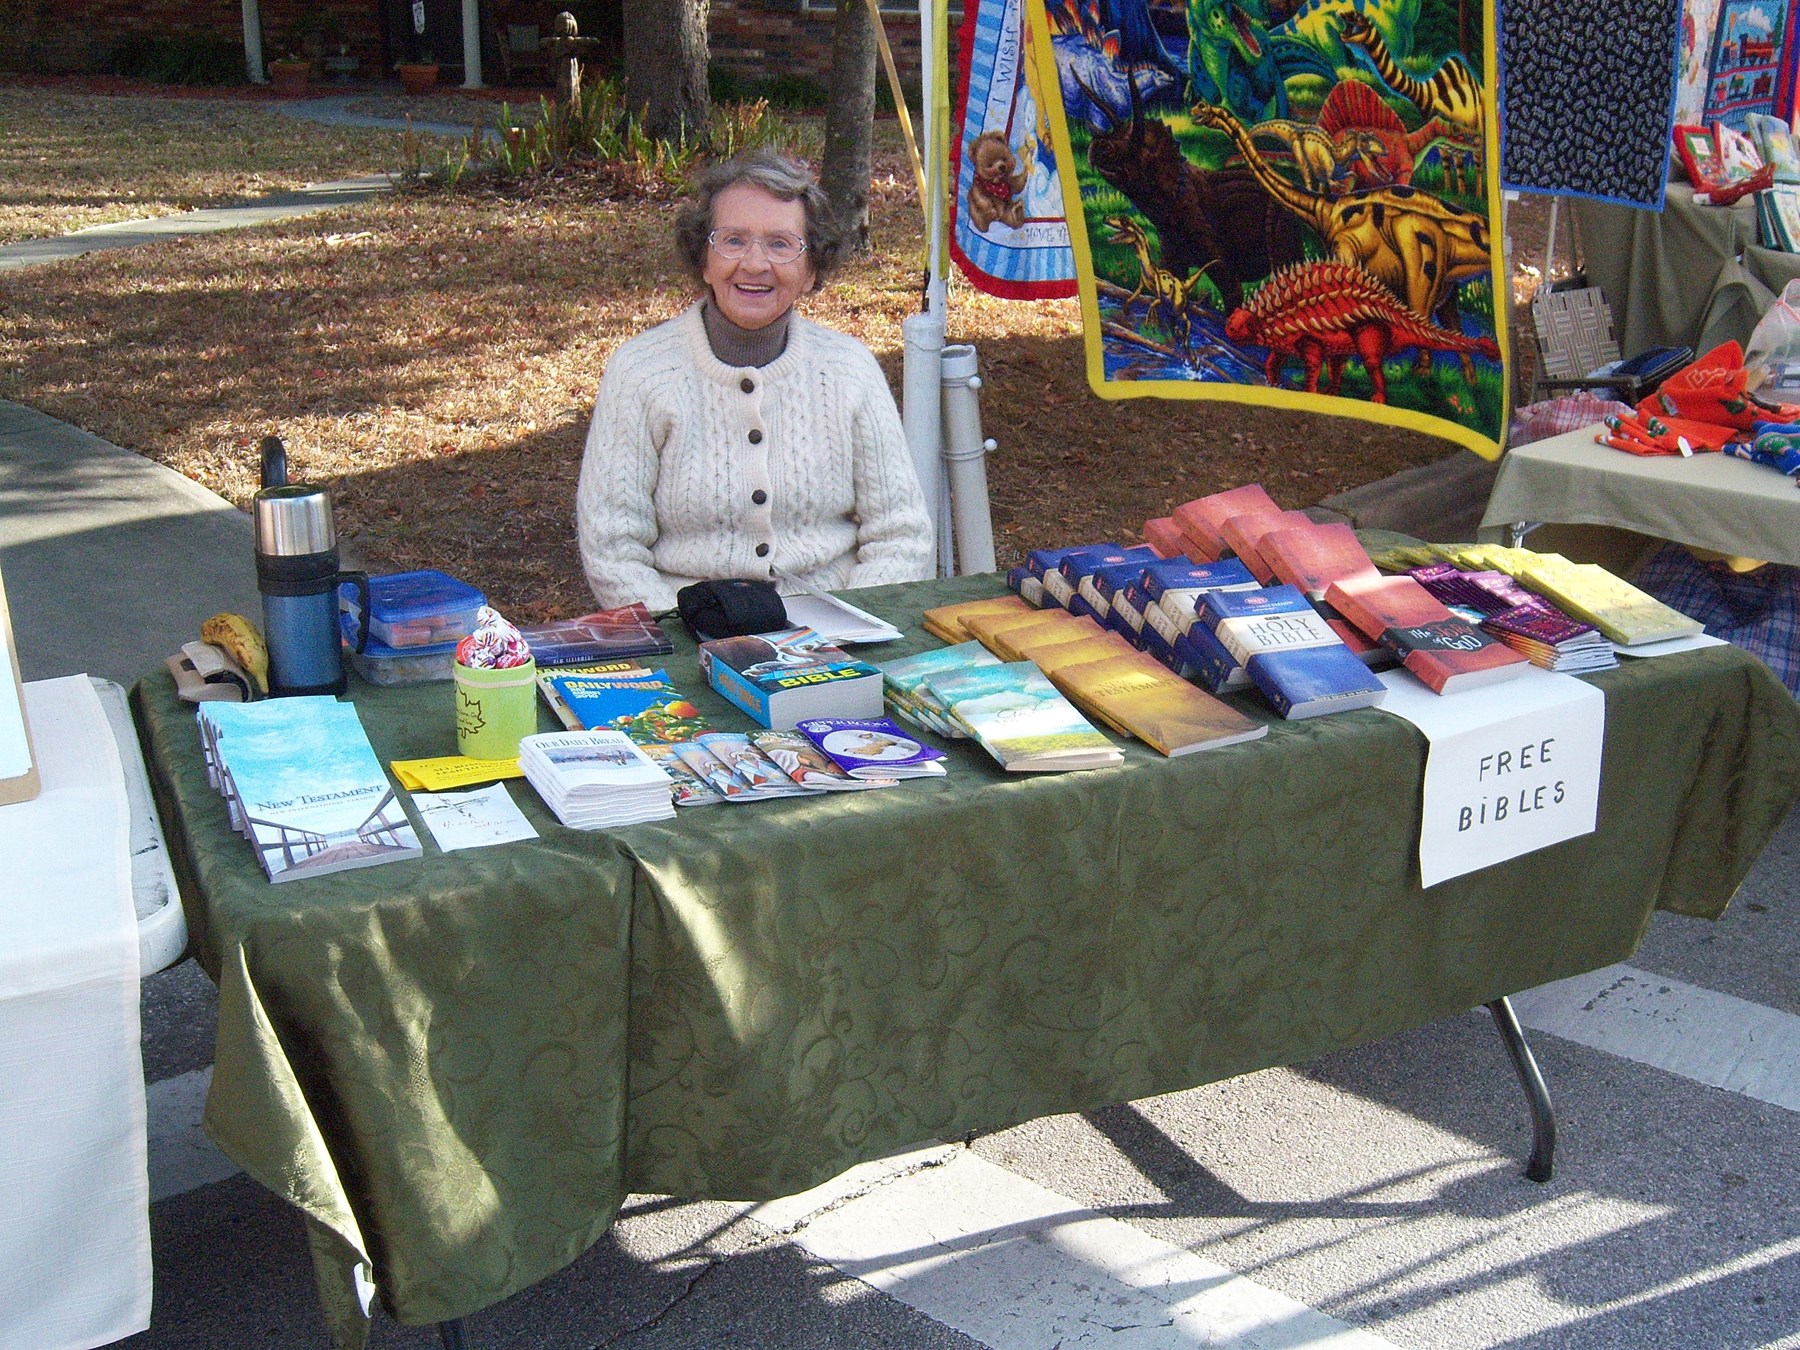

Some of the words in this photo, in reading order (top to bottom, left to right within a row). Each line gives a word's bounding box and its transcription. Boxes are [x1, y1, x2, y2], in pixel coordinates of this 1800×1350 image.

[996, 25, 1019, 83] WISH
[1247, 617, 1313, 636] HOLY
[1256, 628, 1325, 647] BIBLE
[777, 668, 861, 689] BIBLE
[1094, 677, 1179, 698] TESTAMENT
[534, 739, 559, 750] OUR
[559, 737, 588, 748] DAILY
[589, 737, 625, 745] BREAD
[1480, 737, 1555, 782] FREE
